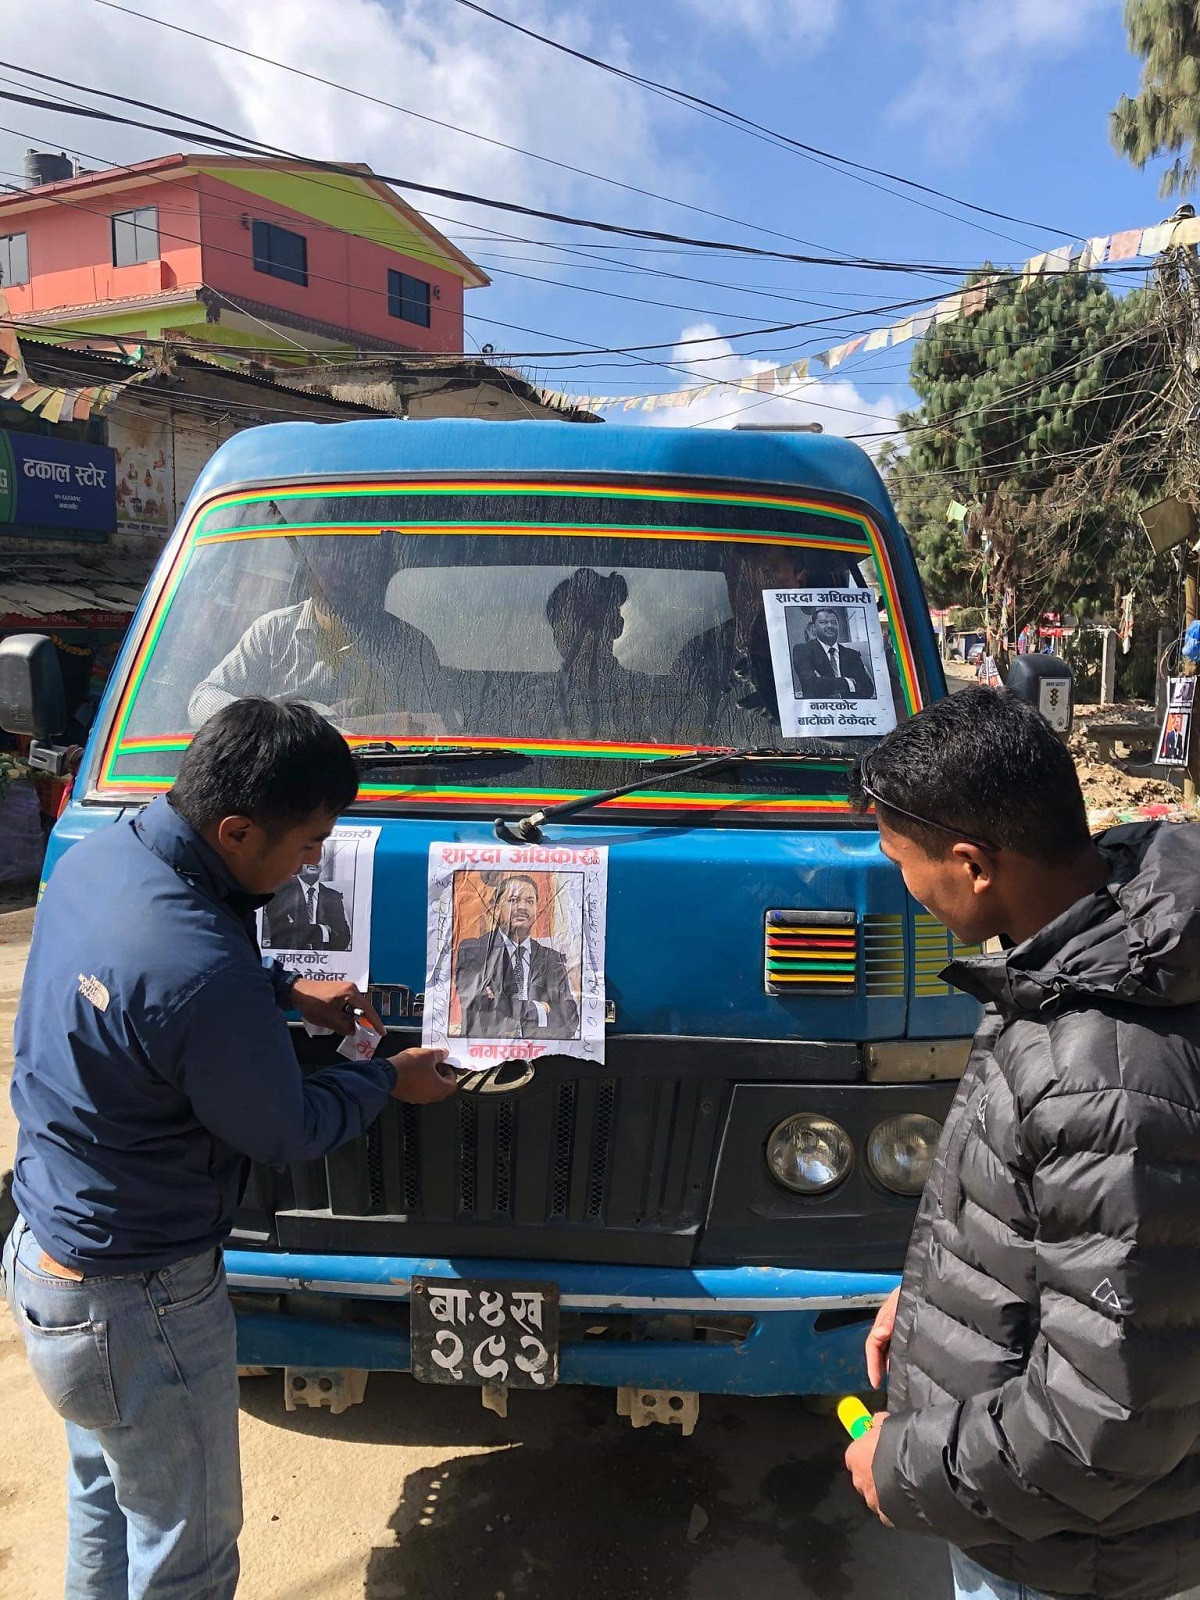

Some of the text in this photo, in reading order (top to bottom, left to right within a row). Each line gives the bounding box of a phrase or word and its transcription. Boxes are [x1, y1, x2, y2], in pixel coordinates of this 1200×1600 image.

[23, 458, 71, 483] ढकाल
[75, 462, 107, 488] स्टोर
[775, 590, 871, 604] शारदा अधिकारी
[809, 700, 857, 710] नगरकोट
[838, 714, 877, 725] ठेकेदार
[442, 848, 500, 864] शारदा
